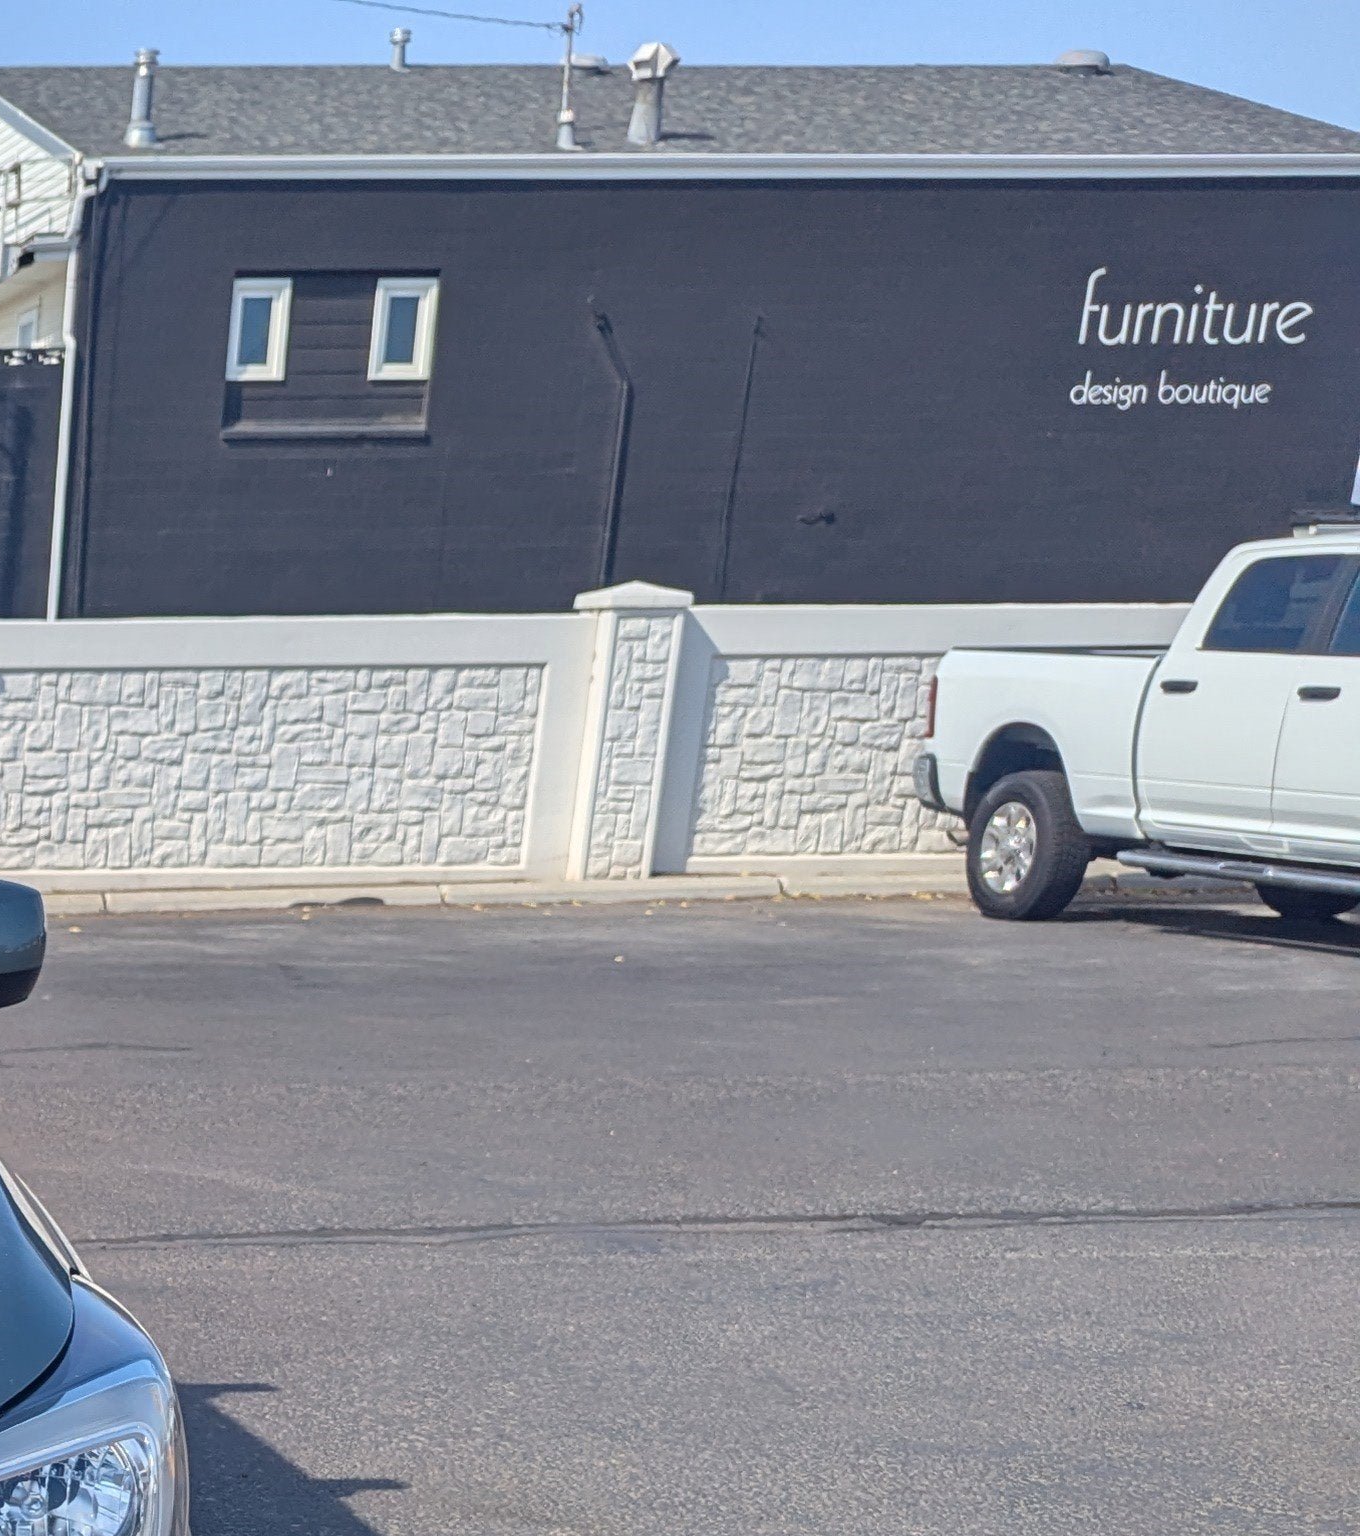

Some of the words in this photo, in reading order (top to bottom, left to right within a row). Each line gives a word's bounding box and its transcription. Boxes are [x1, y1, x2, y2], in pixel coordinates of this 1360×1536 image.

[1078, 266, 1314, 346] furniture
[1069, 370, 1148, 411] design
[1157, 369, 1274, 410] boutique
